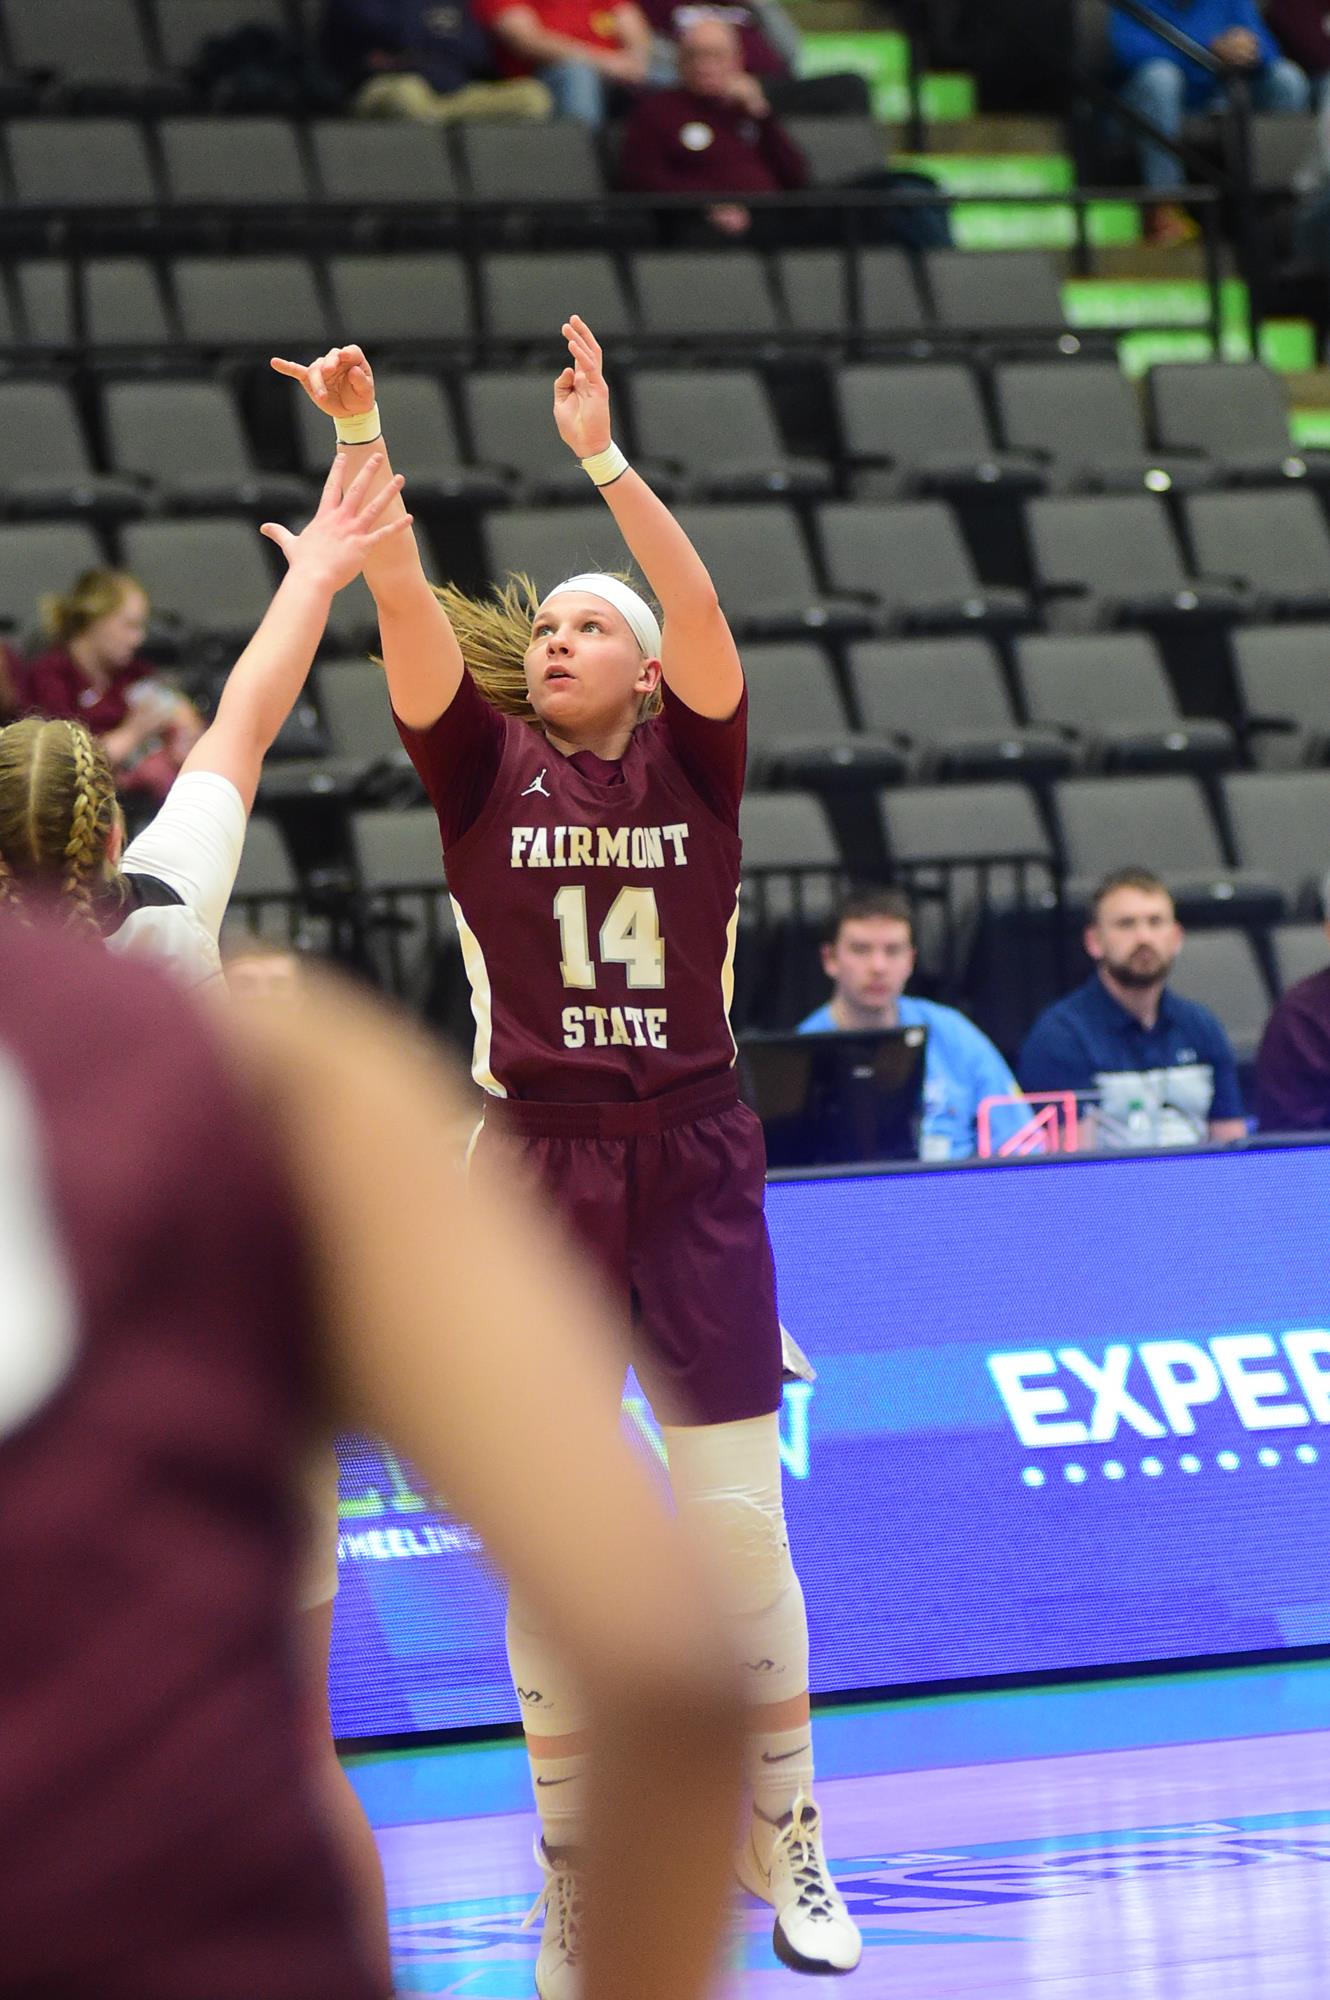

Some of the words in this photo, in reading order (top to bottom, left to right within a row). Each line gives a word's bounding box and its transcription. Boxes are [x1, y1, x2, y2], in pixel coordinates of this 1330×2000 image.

[511, 823, 688, 868] FAIRMONT
[553, 885, 665, 989] 14
[561, 1006, 667, 1049] STATE
